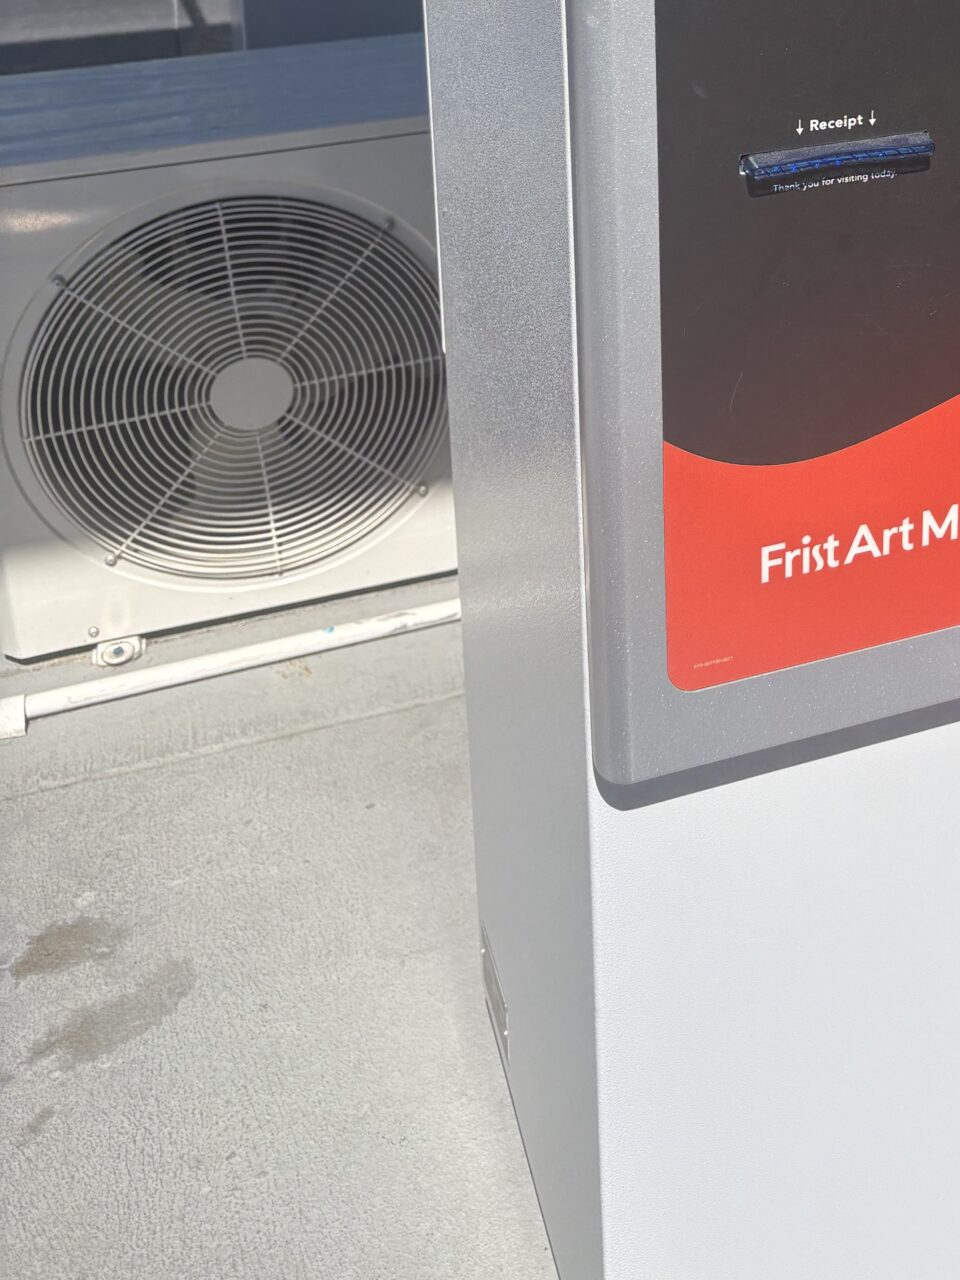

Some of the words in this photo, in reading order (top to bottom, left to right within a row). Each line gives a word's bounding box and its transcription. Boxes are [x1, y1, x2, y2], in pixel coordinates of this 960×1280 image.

[809, 114, 864, 132] Receipt
[772, 181, 800, 193] Thank
[801, 181, 820, 192] you
[821, 176, 835, 187] for
[836, 173, 869, 184] visiting
[760, 533, 840, 584] Frist
[843, 517, 914, 565] Art
